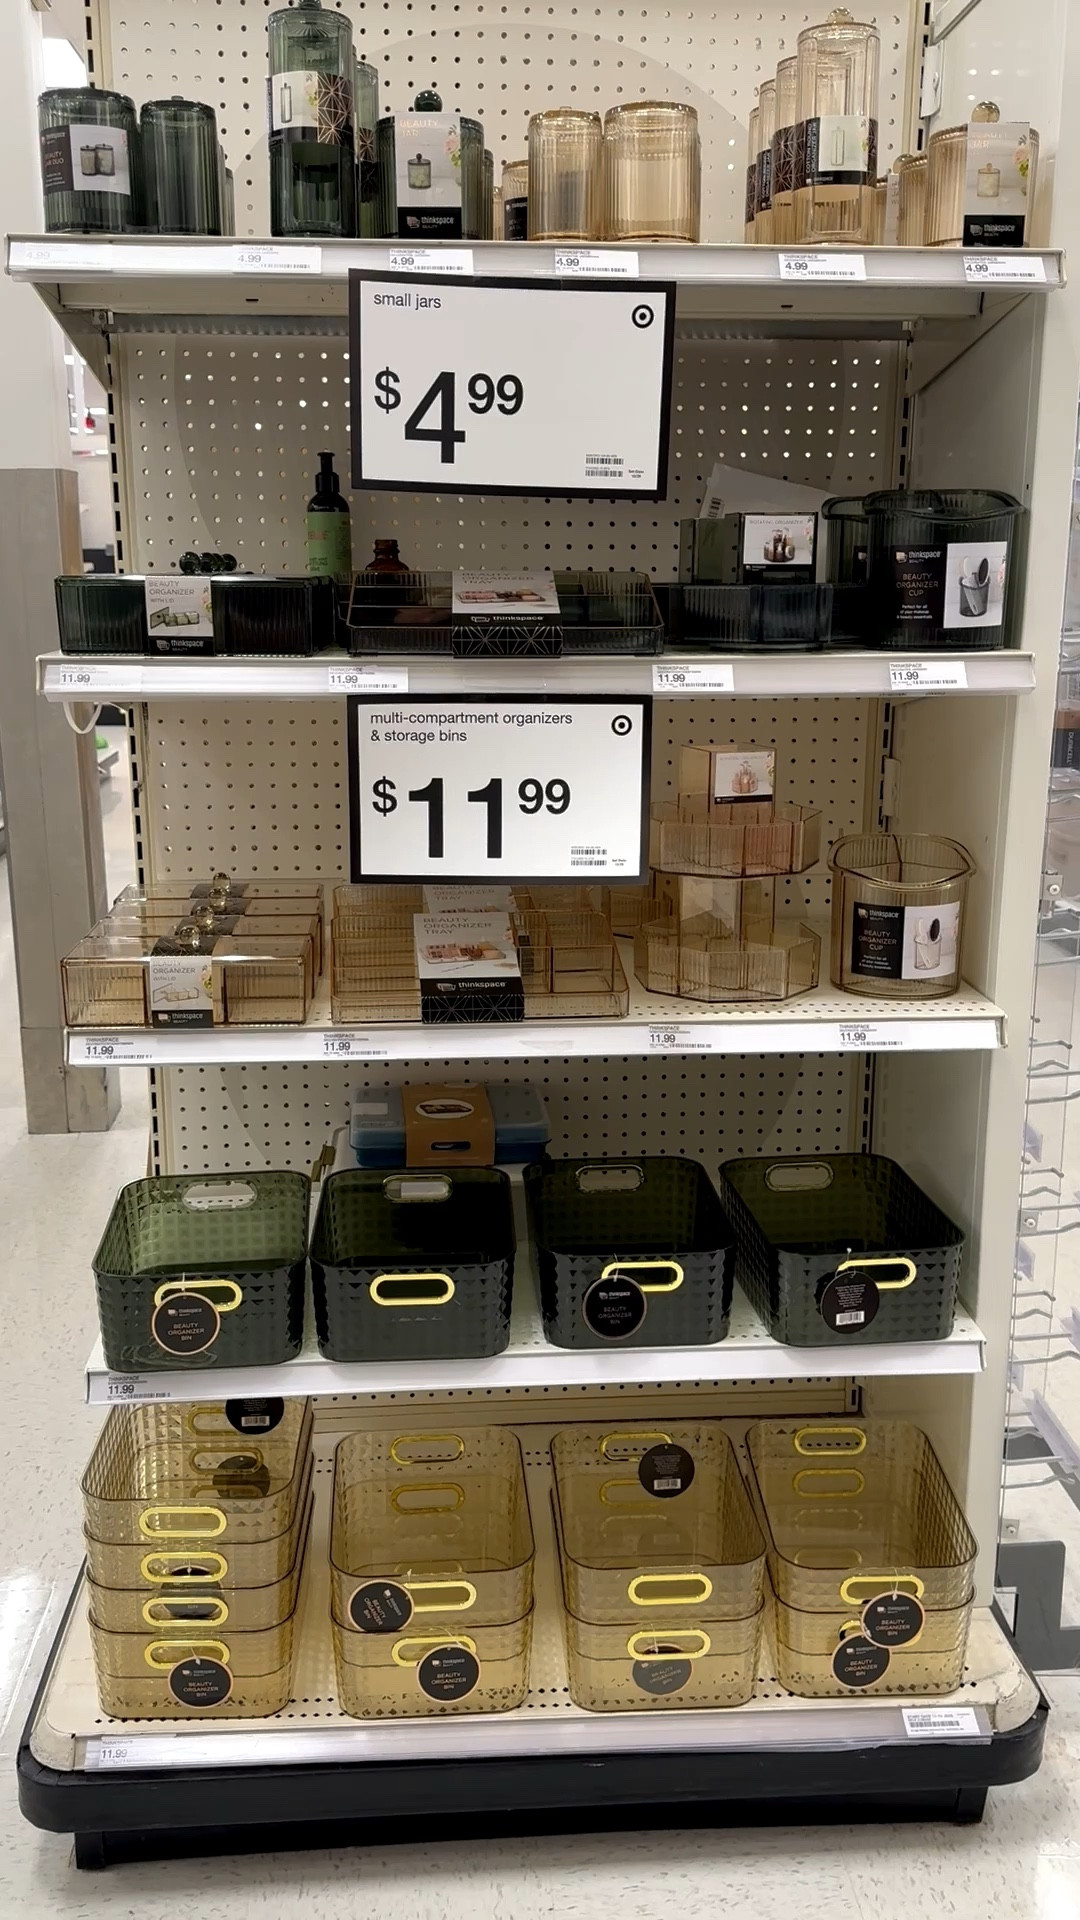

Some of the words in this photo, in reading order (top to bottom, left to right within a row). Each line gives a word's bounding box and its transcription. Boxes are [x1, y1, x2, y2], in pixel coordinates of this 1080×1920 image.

[400, 119, 439, 128] BEAUTY
[238, 254, 262, 263] 4.99
[391, 257, 415, 265] 4.99
[556, 258, 580, 267] 4.99
[785, 262, 808, 271] 4.99
[966, 264, 989, 273] 4.99
[373, 293, 411, 308] small
[414, 294, 442, 311] jars
[909, 551, 942, 560] thinkspace
[896, 581, 939, 589] ORGANIZER
[149, 588, 195, 596] ORGANIZER
[909, 589, 924, 597] CUP
[171, 640, 204, 648] thinkspace
[61, 673, 91, 683] 11.99
[330, 675, 358, 684] 11.99
[658, 673, 686, 683] 11.99
[891, 671, 919, 681] 11.99
[370, 711, 499, 727] multi-compartment
[503, 712, 573, 728] organizers
[370, 730, 381, 742] &
[384, 730, 435, 744] storage
[439, 730, 467, 742] bins
[869, 909, 899, 918] thinkspace
[864, 929, 891, 937] BEAUTY
[858, 935, 897, 944] ORGANIZER
[650, 1034, 676, 1043] 11.99
[840, 1032, 867, 1041] 11.99
[86, 1046, 114, 1055] 11.99
[324, 1042, 351, 1051] 11.99
[168, 1328, 205, 1336] ORGANIZER
[108, 1384, 135, 1394] 11.99
[364, 1597, 383, 1625] ORGANIZER
[372, 1599, 387, 1618] BEAUTY
[844, 1664, 878, 1672] ORGANIZER
[431, 1677, 467, 1685] ORGANIZER
[102, 1749, 128, 1758] 11.99
